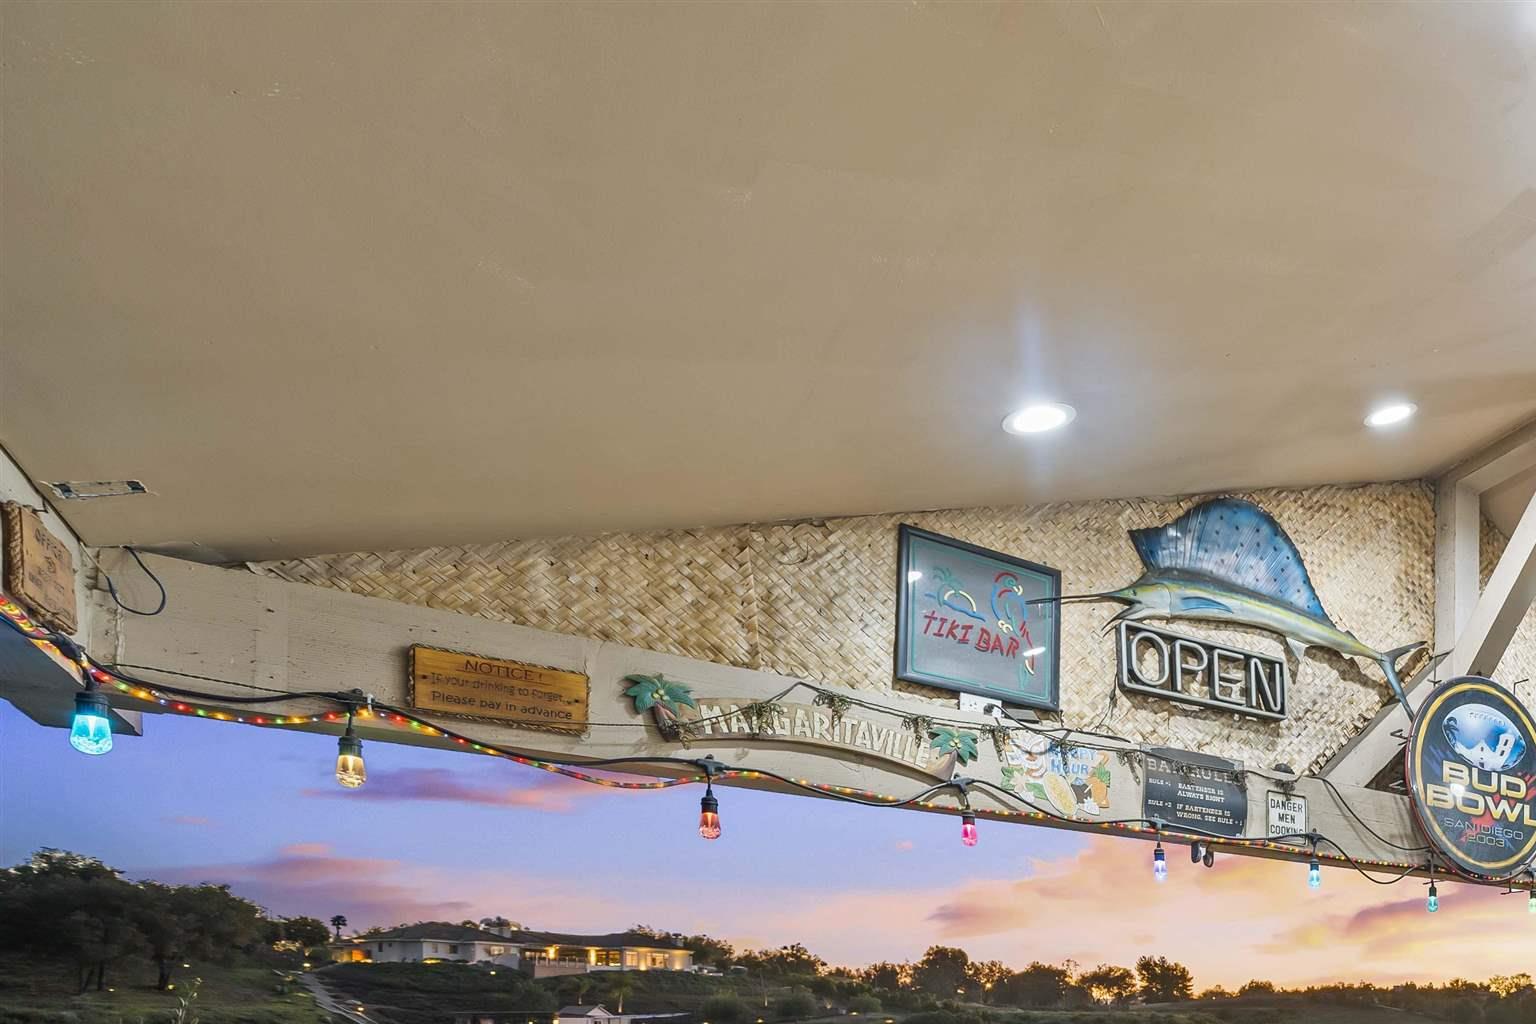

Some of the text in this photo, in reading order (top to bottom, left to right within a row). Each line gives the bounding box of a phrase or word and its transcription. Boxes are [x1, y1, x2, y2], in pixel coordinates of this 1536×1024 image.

[924, 610, 1021, 659] TIKI BAR
[1131, 631, 1282, 712] OPEN
[518, 687, 530, 698] to
[432, 690, 573, 720] Please pay in advance
[1189, 766, 1242, 785] RULE
[1442, 760, 1527, 799] BUD
[1177, 783, 1216, 795] BARTENDER
[1177, 790, 1225, 803] ALWAYS RIGHT
[1148, 799, 1164, 807] RULE
[1185, 804, 1223, 816] BARTENDER
[1270, 798, 1303, 813] DANGER
[1278, 812, 1296, 825] MEN
[1444, 818, 1524, 840] SAN DIEGO
[1467, 832, 1505, 848] 2003
